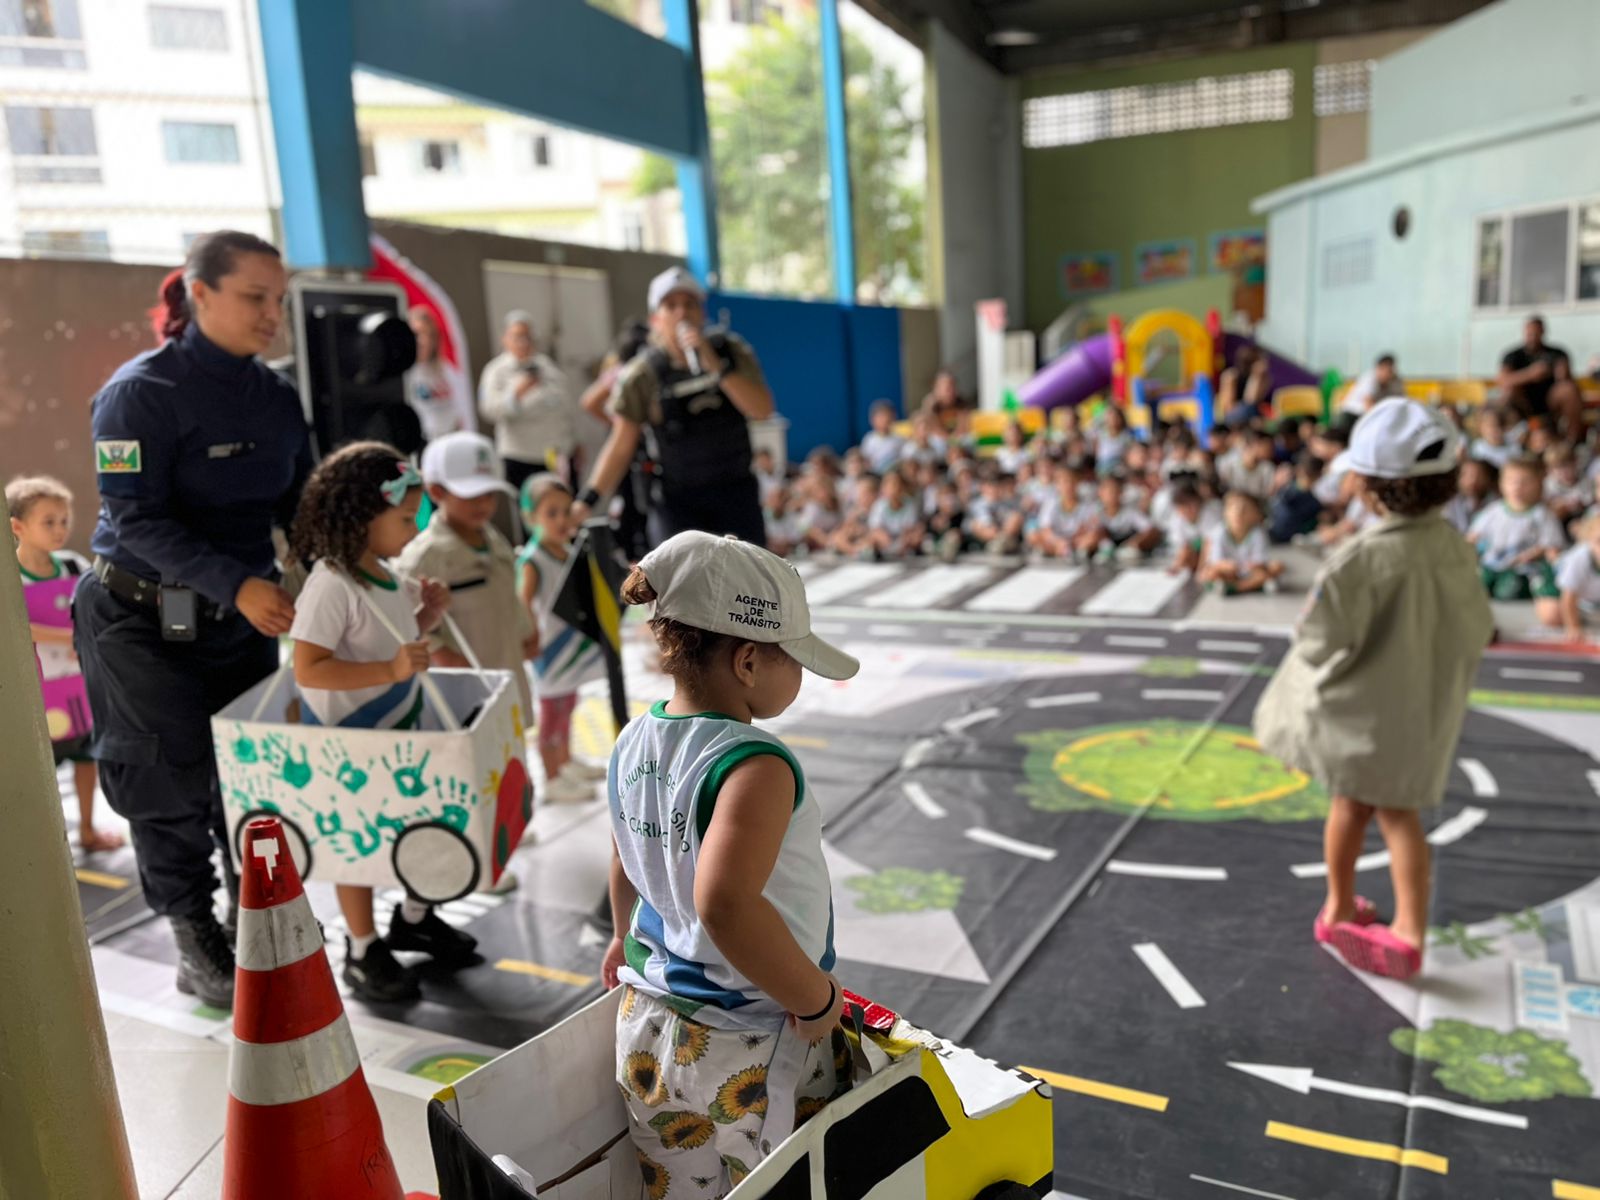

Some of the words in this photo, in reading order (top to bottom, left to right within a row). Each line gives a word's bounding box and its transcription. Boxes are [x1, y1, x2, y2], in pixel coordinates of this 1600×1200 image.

[735, 594, 778, 610] AGENTE
[750, 607, 764, 617] DE
[728, 612, 781, 629] TRÂNSITO
